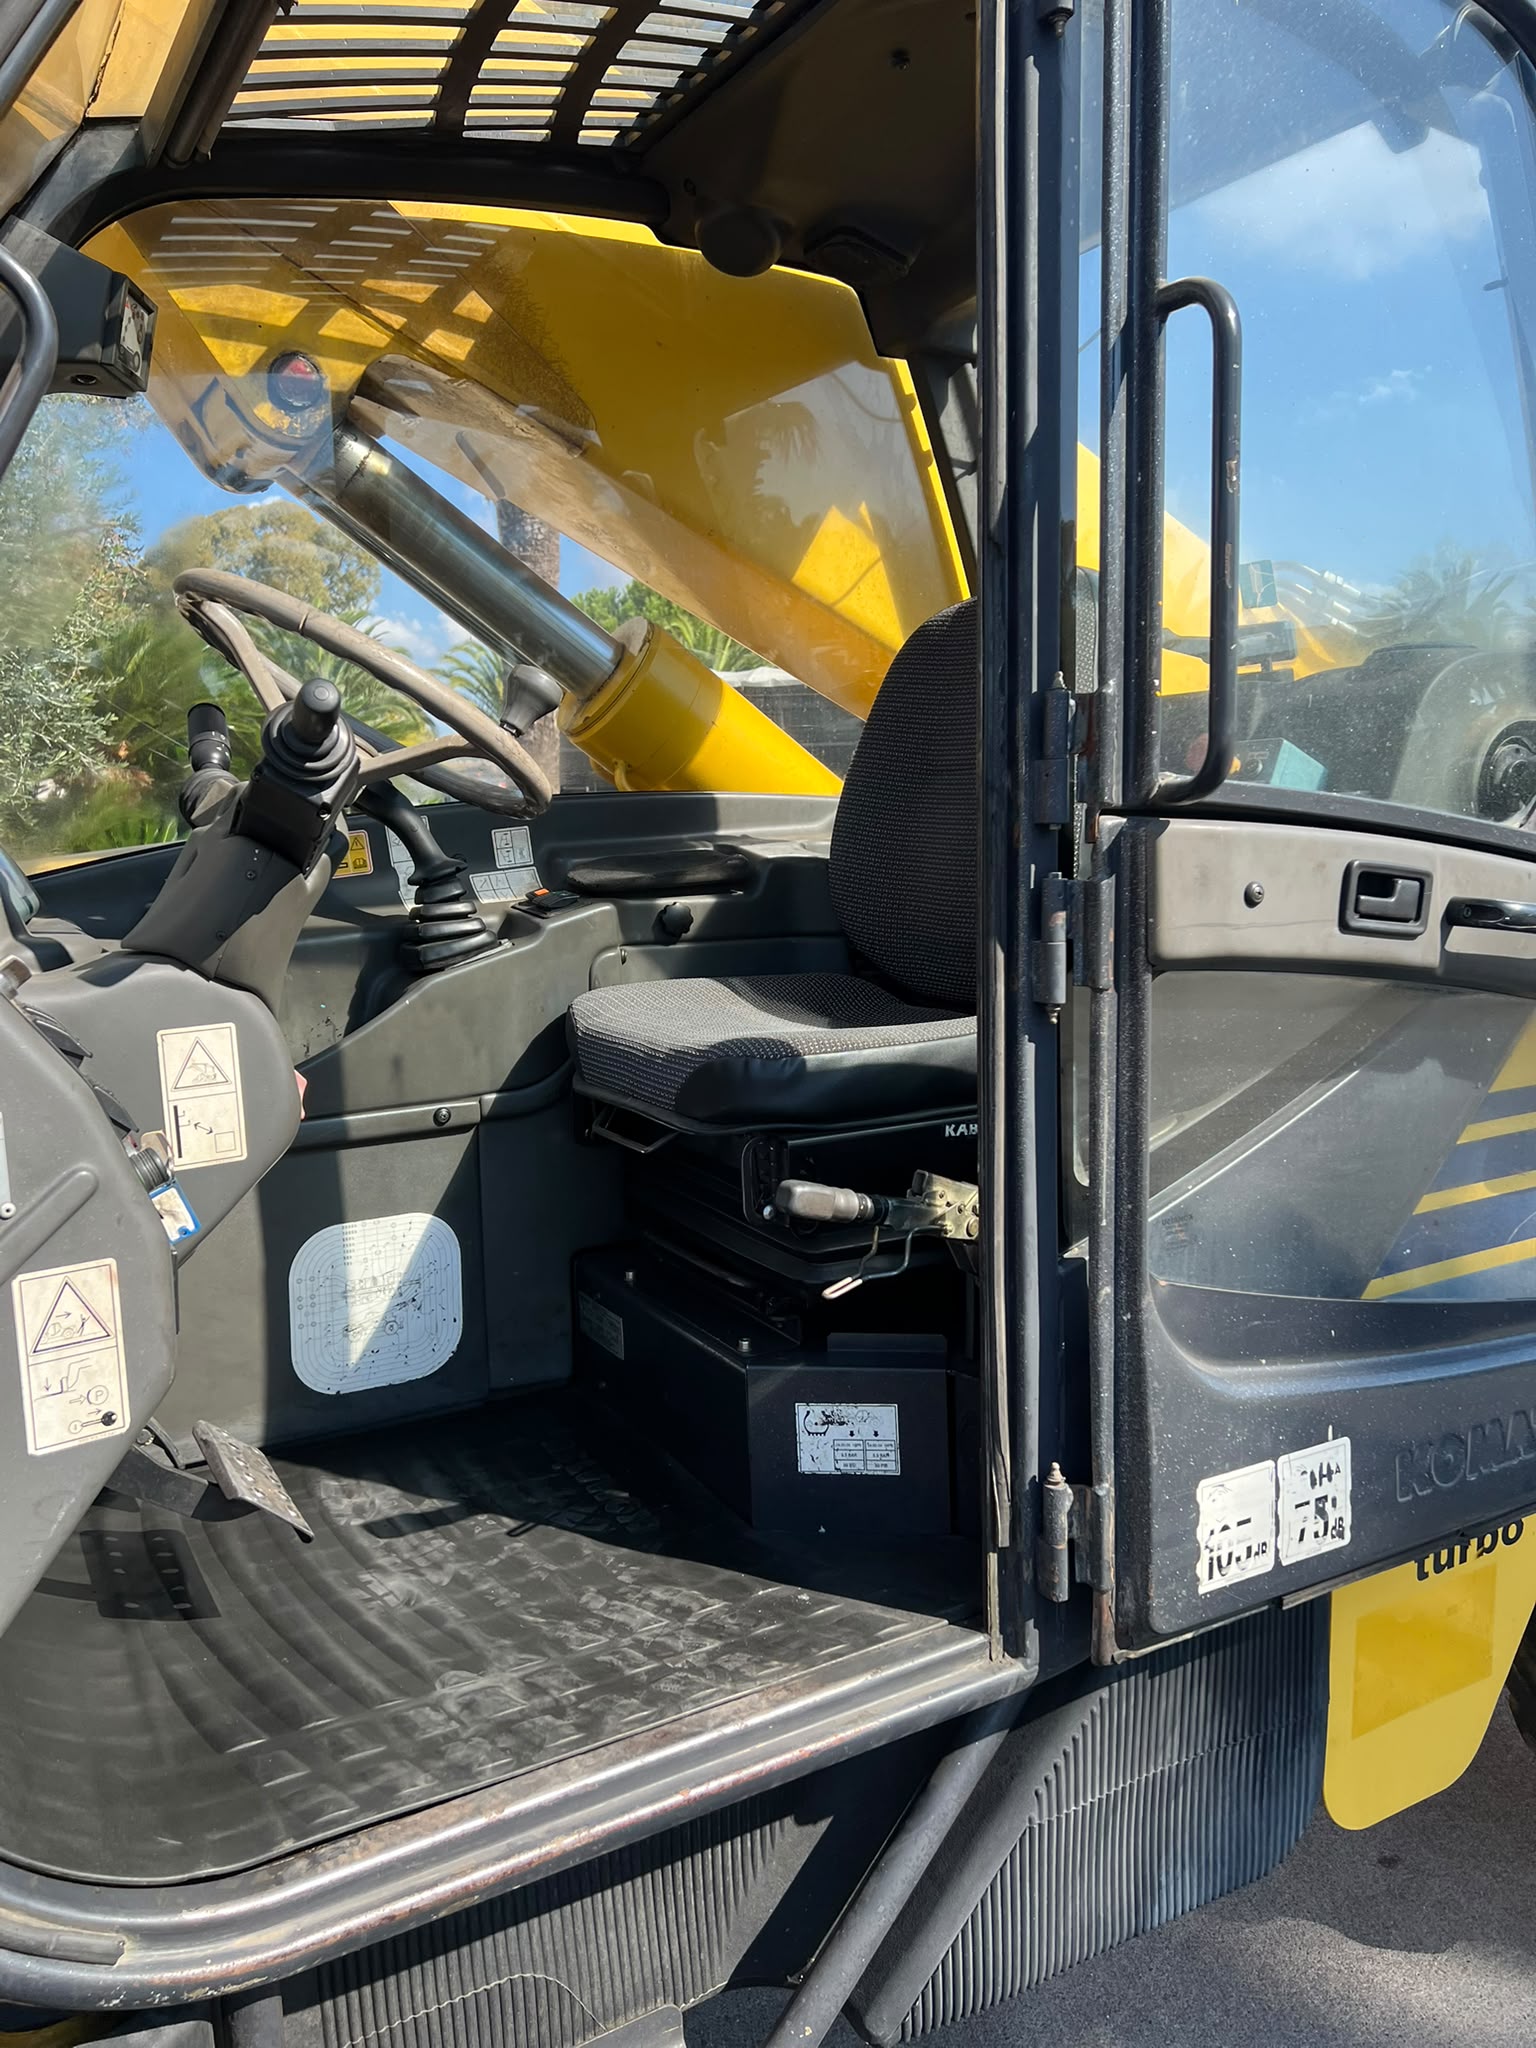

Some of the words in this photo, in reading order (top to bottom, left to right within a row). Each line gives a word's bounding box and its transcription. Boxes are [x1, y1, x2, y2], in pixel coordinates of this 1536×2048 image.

[945, 1123, 978, 1137] KAB
[1395, 1408, 1536, 1502] KOMA
[1414, 1518, 1524, 1581] turbo
